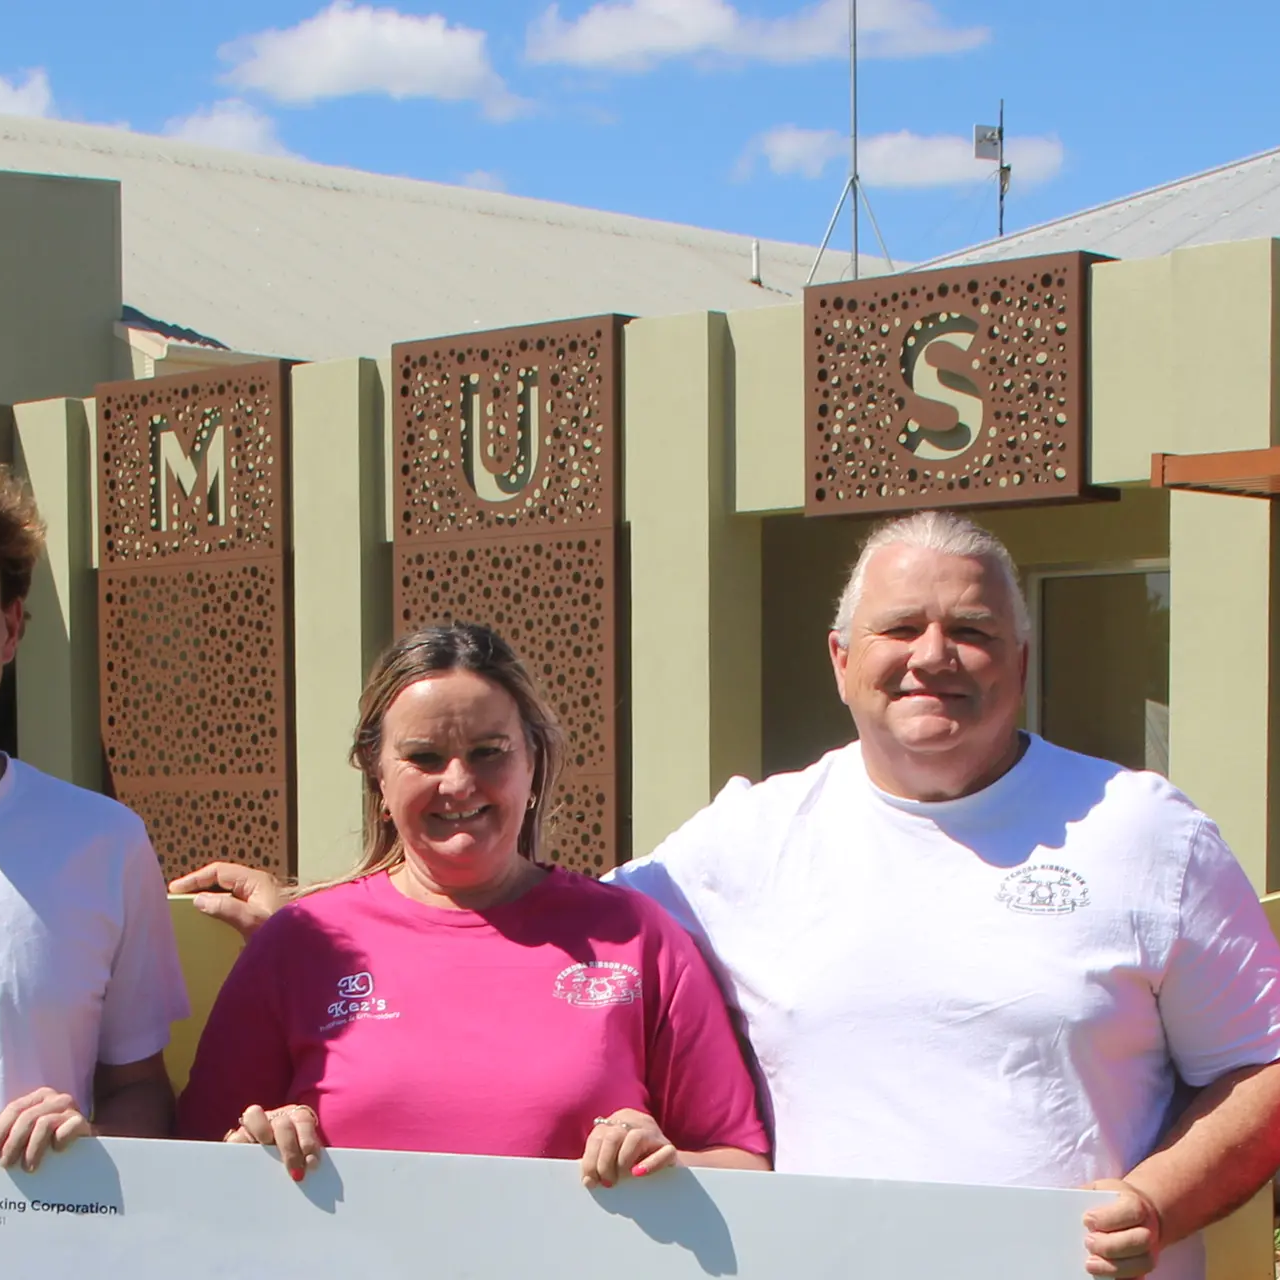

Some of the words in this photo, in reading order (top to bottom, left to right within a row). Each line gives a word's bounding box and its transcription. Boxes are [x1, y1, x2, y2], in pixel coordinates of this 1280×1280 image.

[1040, 864, 1071, 874] RIBBON
[327, 997, 387, 1018] Kez's
[30, 1200, 118, 1215] Corporation
